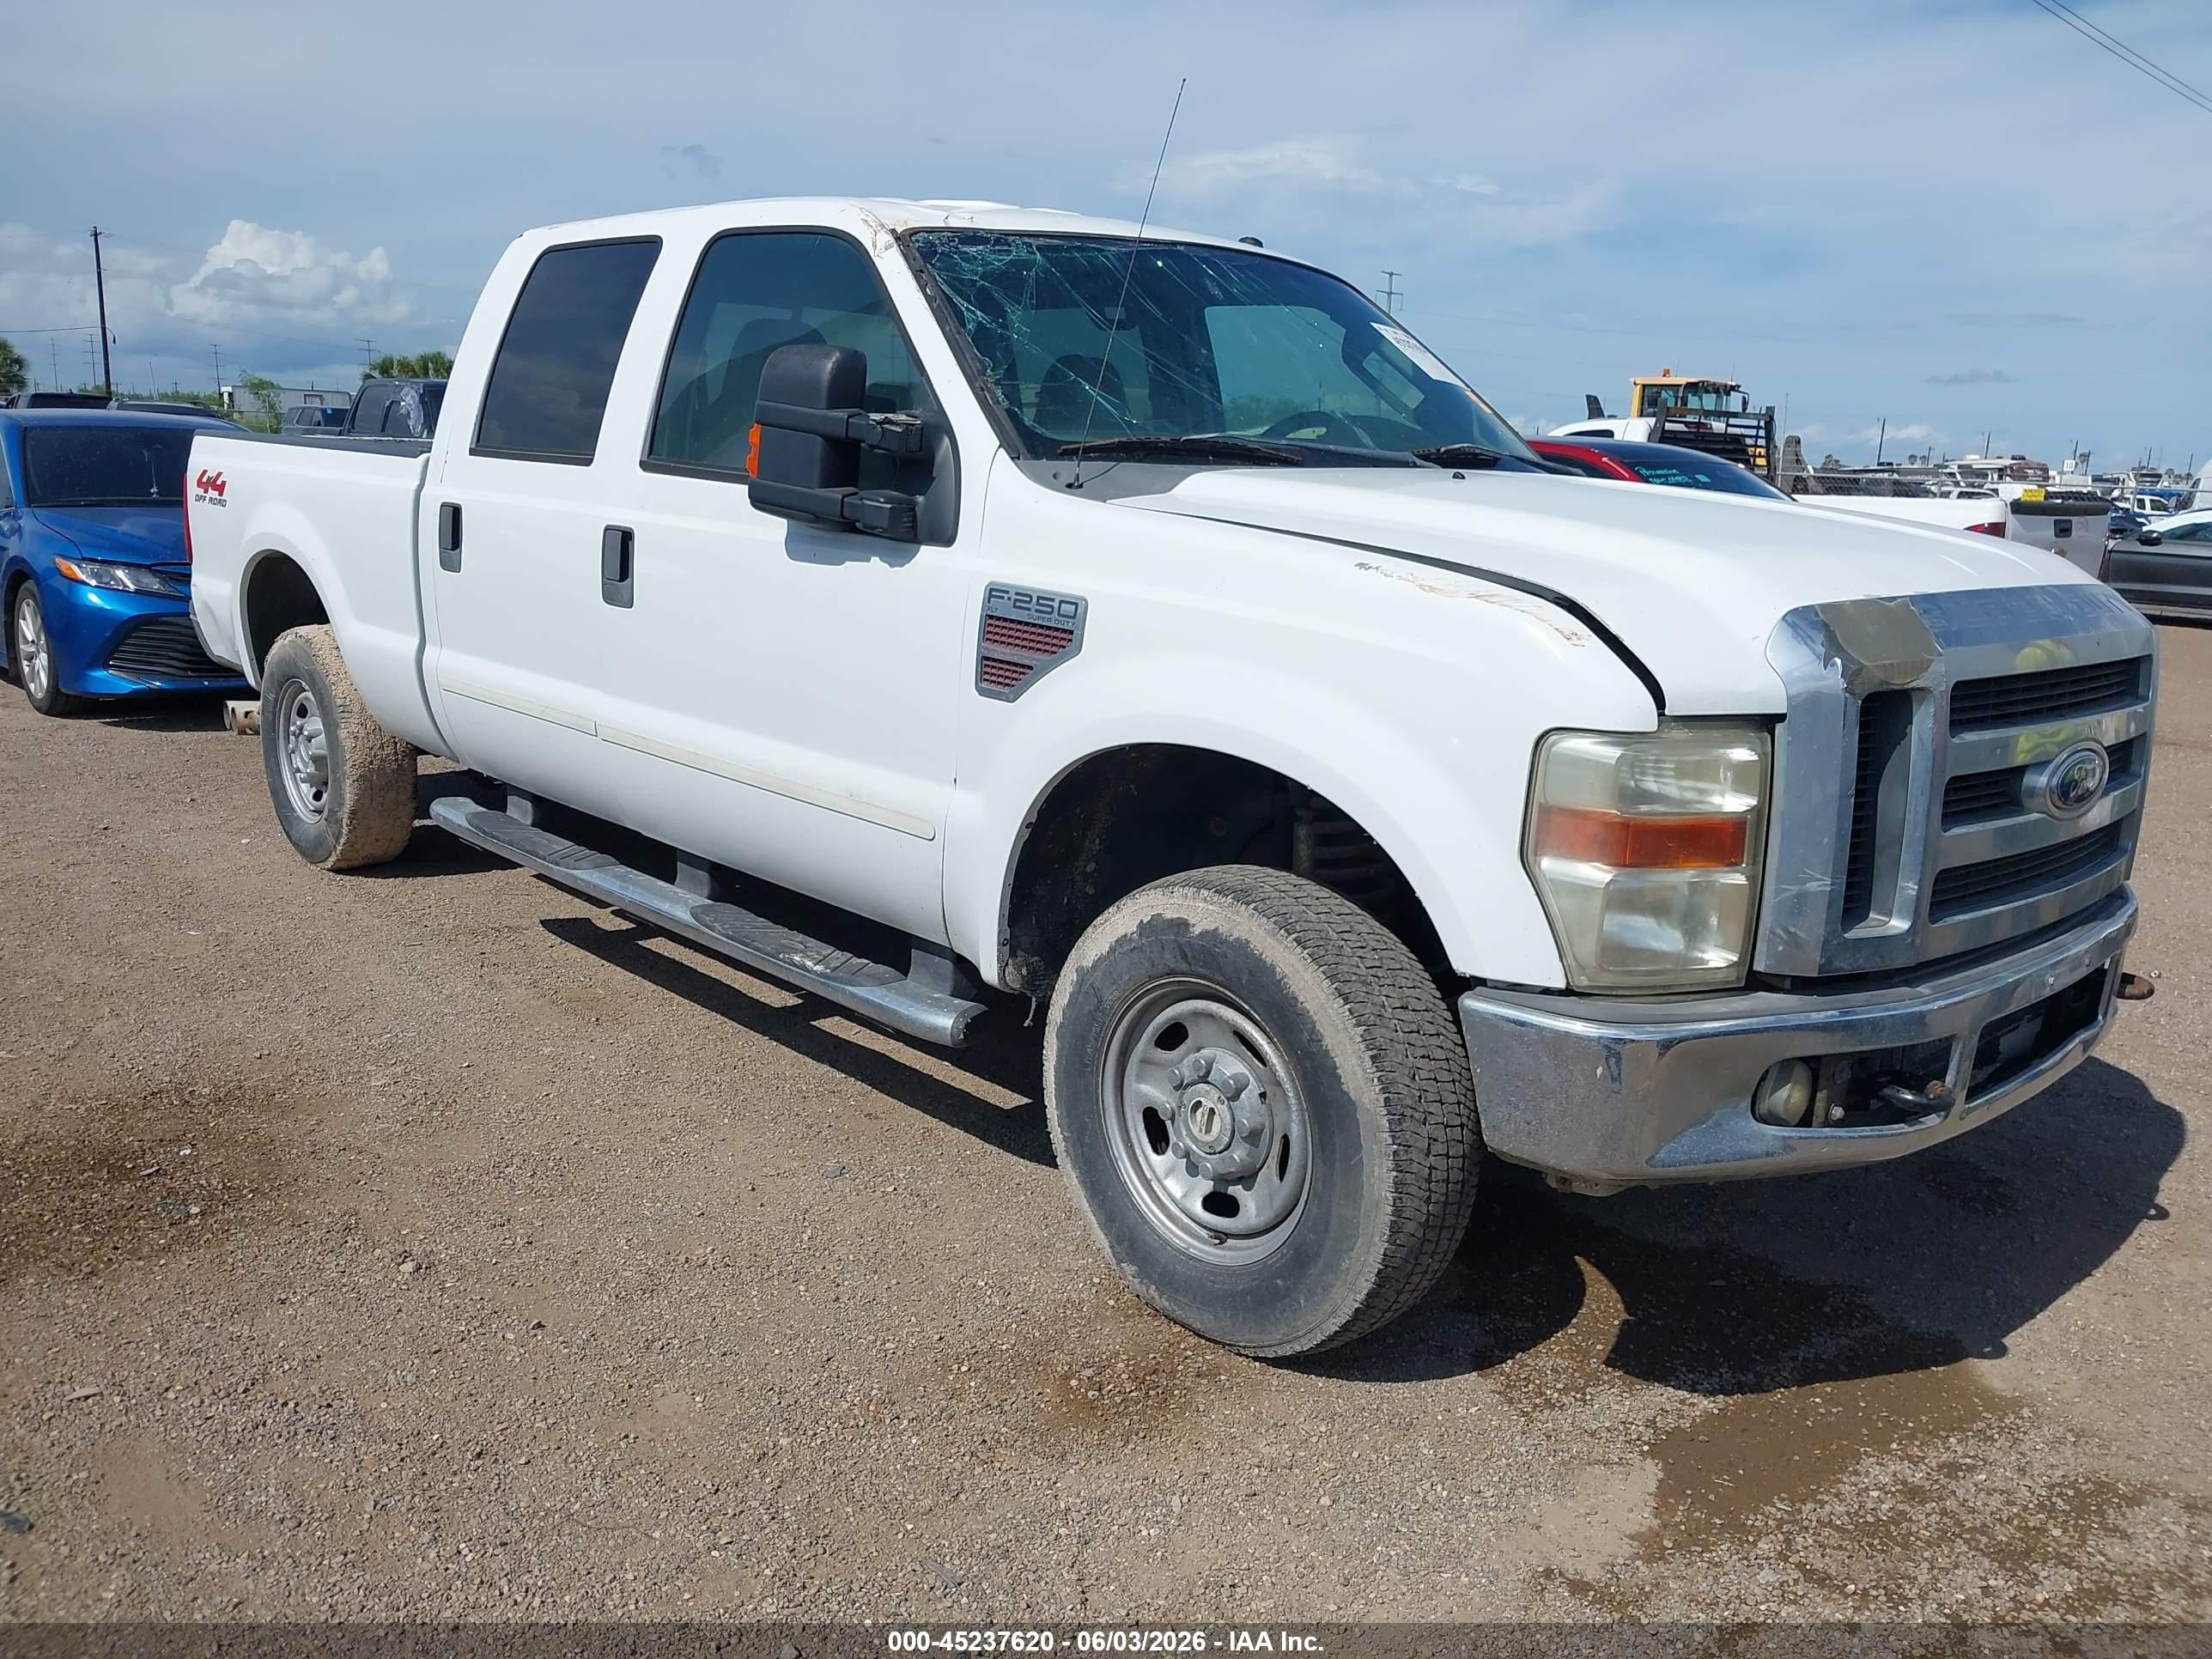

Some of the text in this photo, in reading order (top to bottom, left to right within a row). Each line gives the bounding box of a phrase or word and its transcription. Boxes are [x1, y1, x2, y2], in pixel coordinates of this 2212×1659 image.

[194, 494, 228, 508] OFF ROAD
[987, 587, 1079, 620] F-250
[1026, 613, 1076, 629] SUPER DUTY
